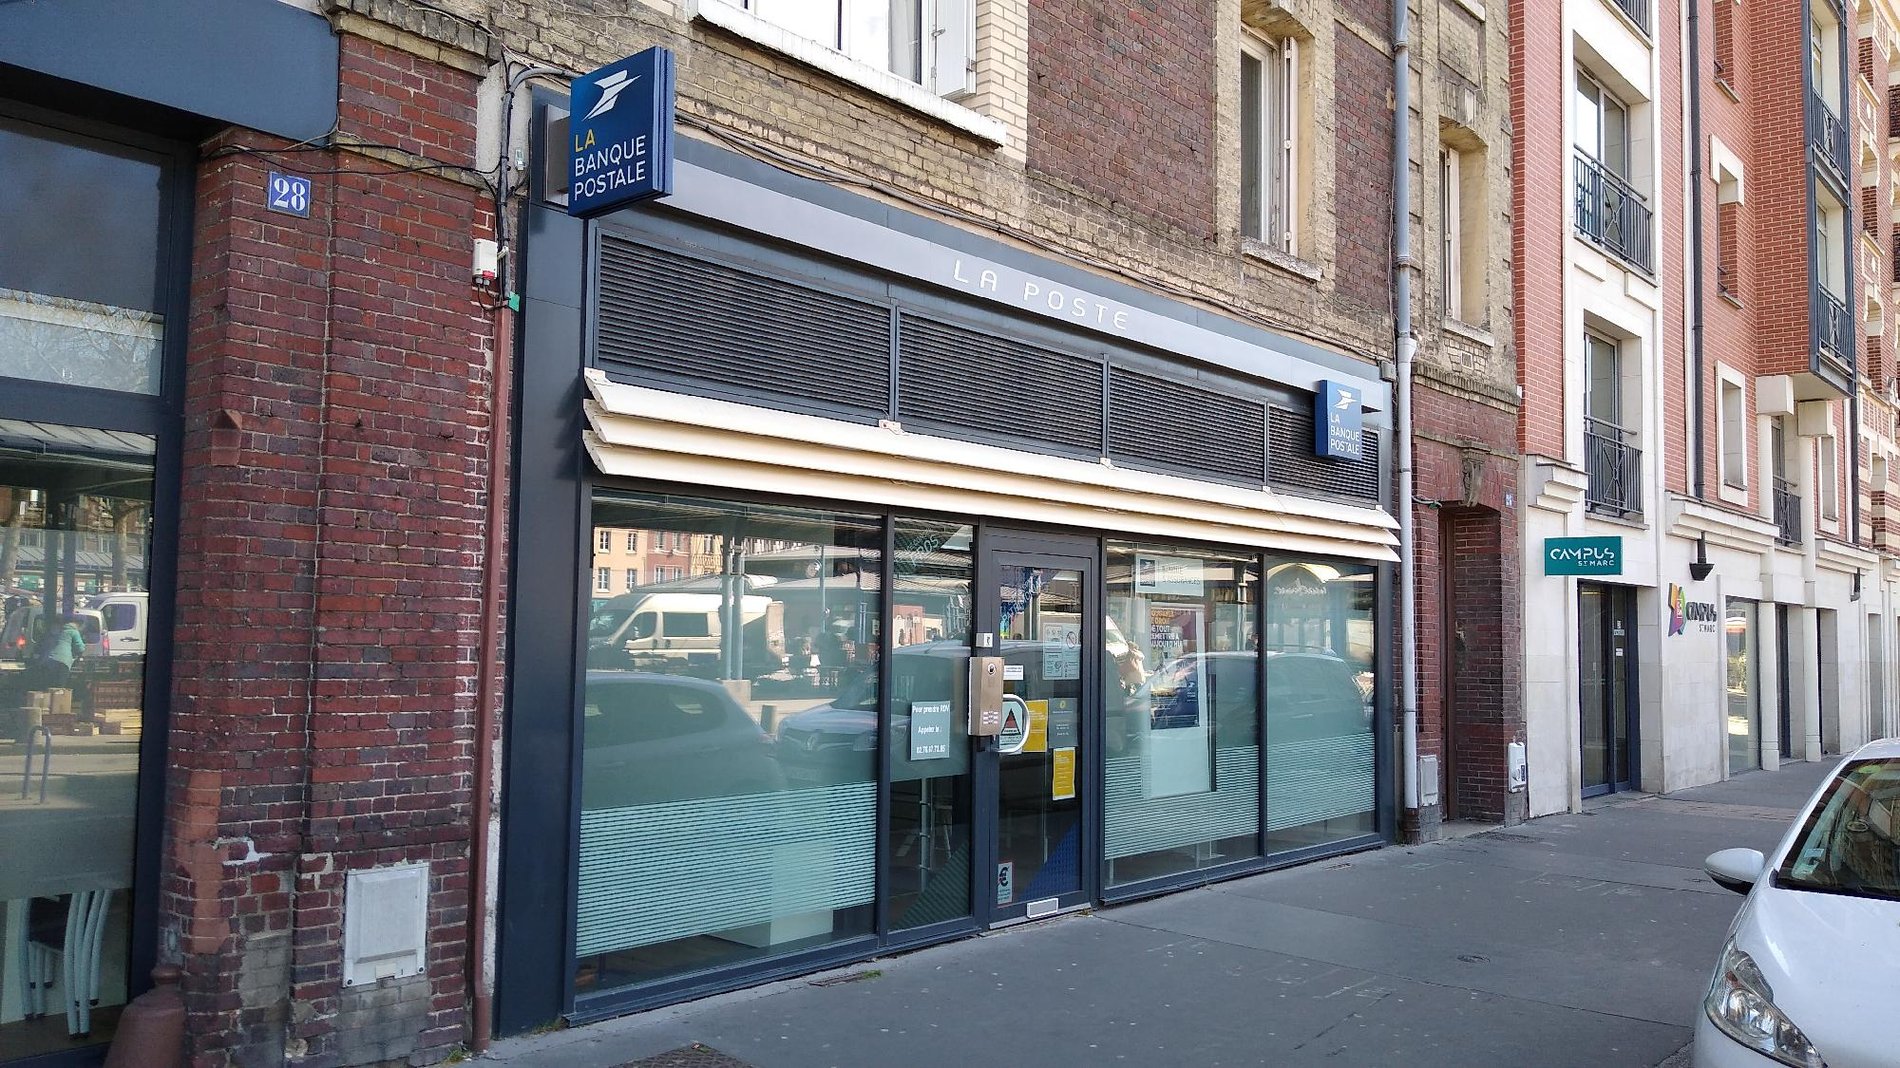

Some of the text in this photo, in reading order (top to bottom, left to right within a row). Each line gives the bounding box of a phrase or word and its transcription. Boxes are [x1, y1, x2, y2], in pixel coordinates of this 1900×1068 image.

[574, 129, 596, 153] LA
[574, 134, 647, 177] BANQUE
[573, 160, 647, 201] POSTALE
[273, 178, 306, 212] 28
[953, 258, 1128, 331] LA POSTE
[1330, 412, 1341, 425] LA
[1330, 425, 1360, 443] BANQUE
[1329, 438, 1360, 456] POSTALE
[1550, 547, 1615, 560] CAMPUS
[1685, 601, 1717, 622] CAMPUS
